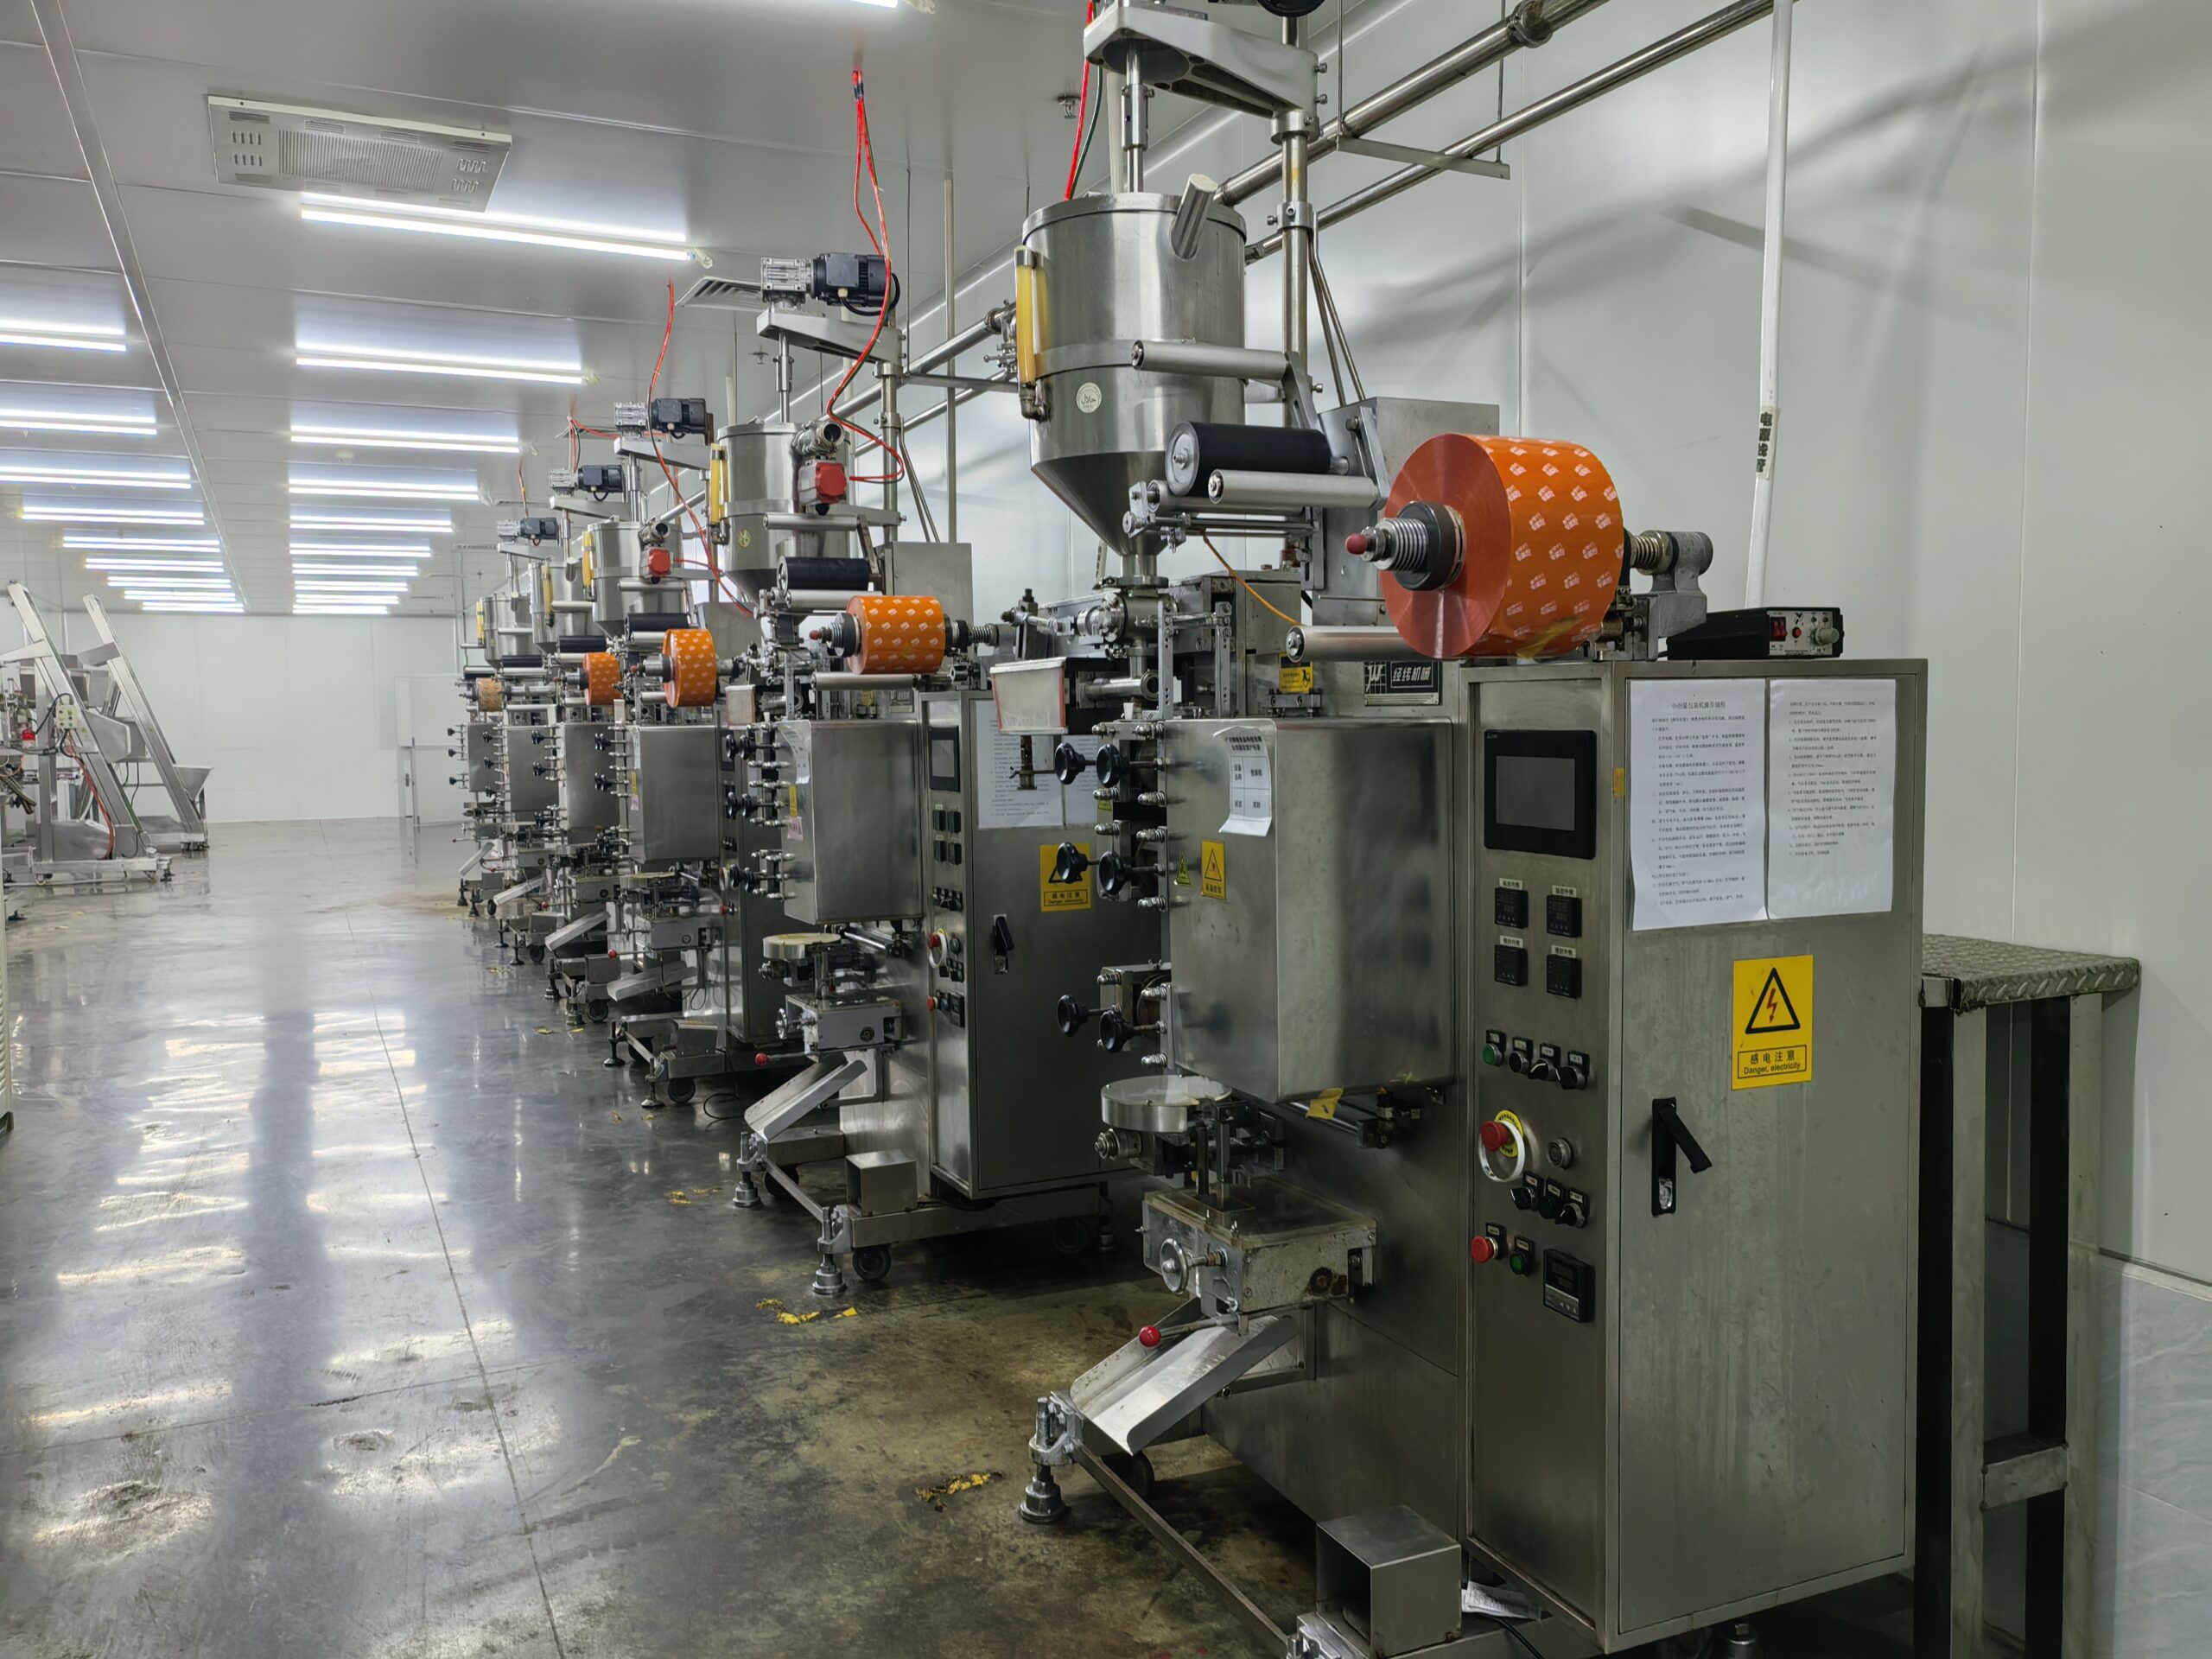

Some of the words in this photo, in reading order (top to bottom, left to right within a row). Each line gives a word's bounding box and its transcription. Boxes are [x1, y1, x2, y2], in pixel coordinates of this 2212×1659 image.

[1392, 666, 1432, 682] 经纬机械
[1751, 1050, 1795, 1065] 感电注意
[1744, 1065, 1769, 1075] Danger,
[1770, 1061, 1801, 1072] electricity
